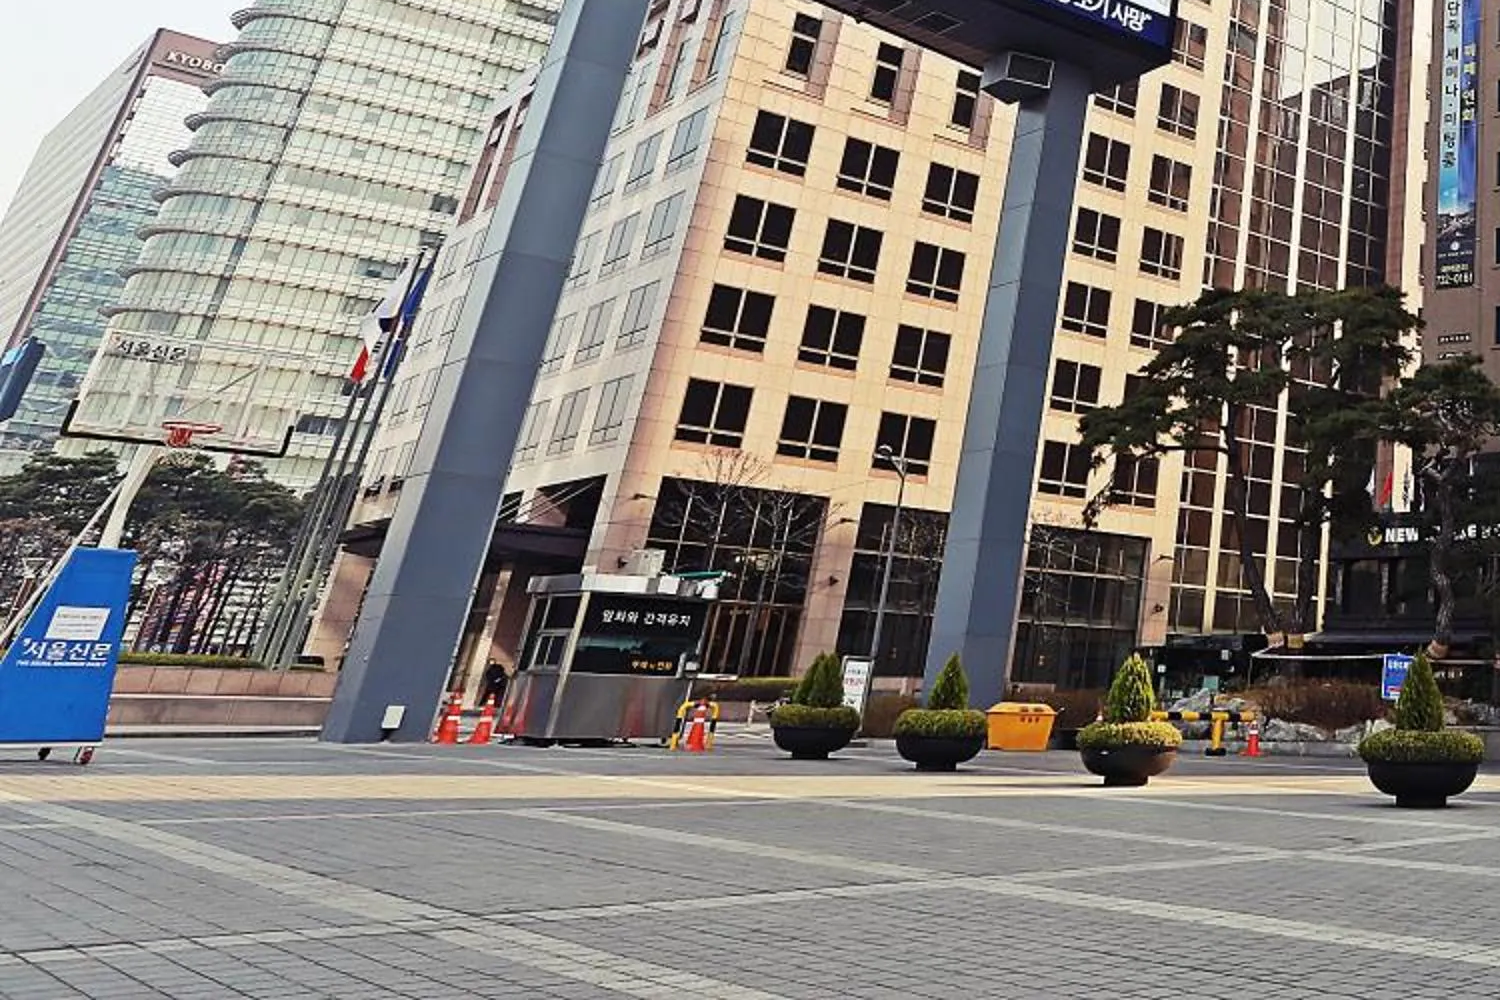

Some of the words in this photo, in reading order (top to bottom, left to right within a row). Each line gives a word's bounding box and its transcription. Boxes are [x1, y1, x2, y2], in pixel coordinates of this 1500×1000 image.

[166, 50, 226, 74] KYOBO
[118, 340, 187, 361] 서울신문
[1385, 527, 1419, 543] NEW
[23, 640, 112, 660] 서울신문
